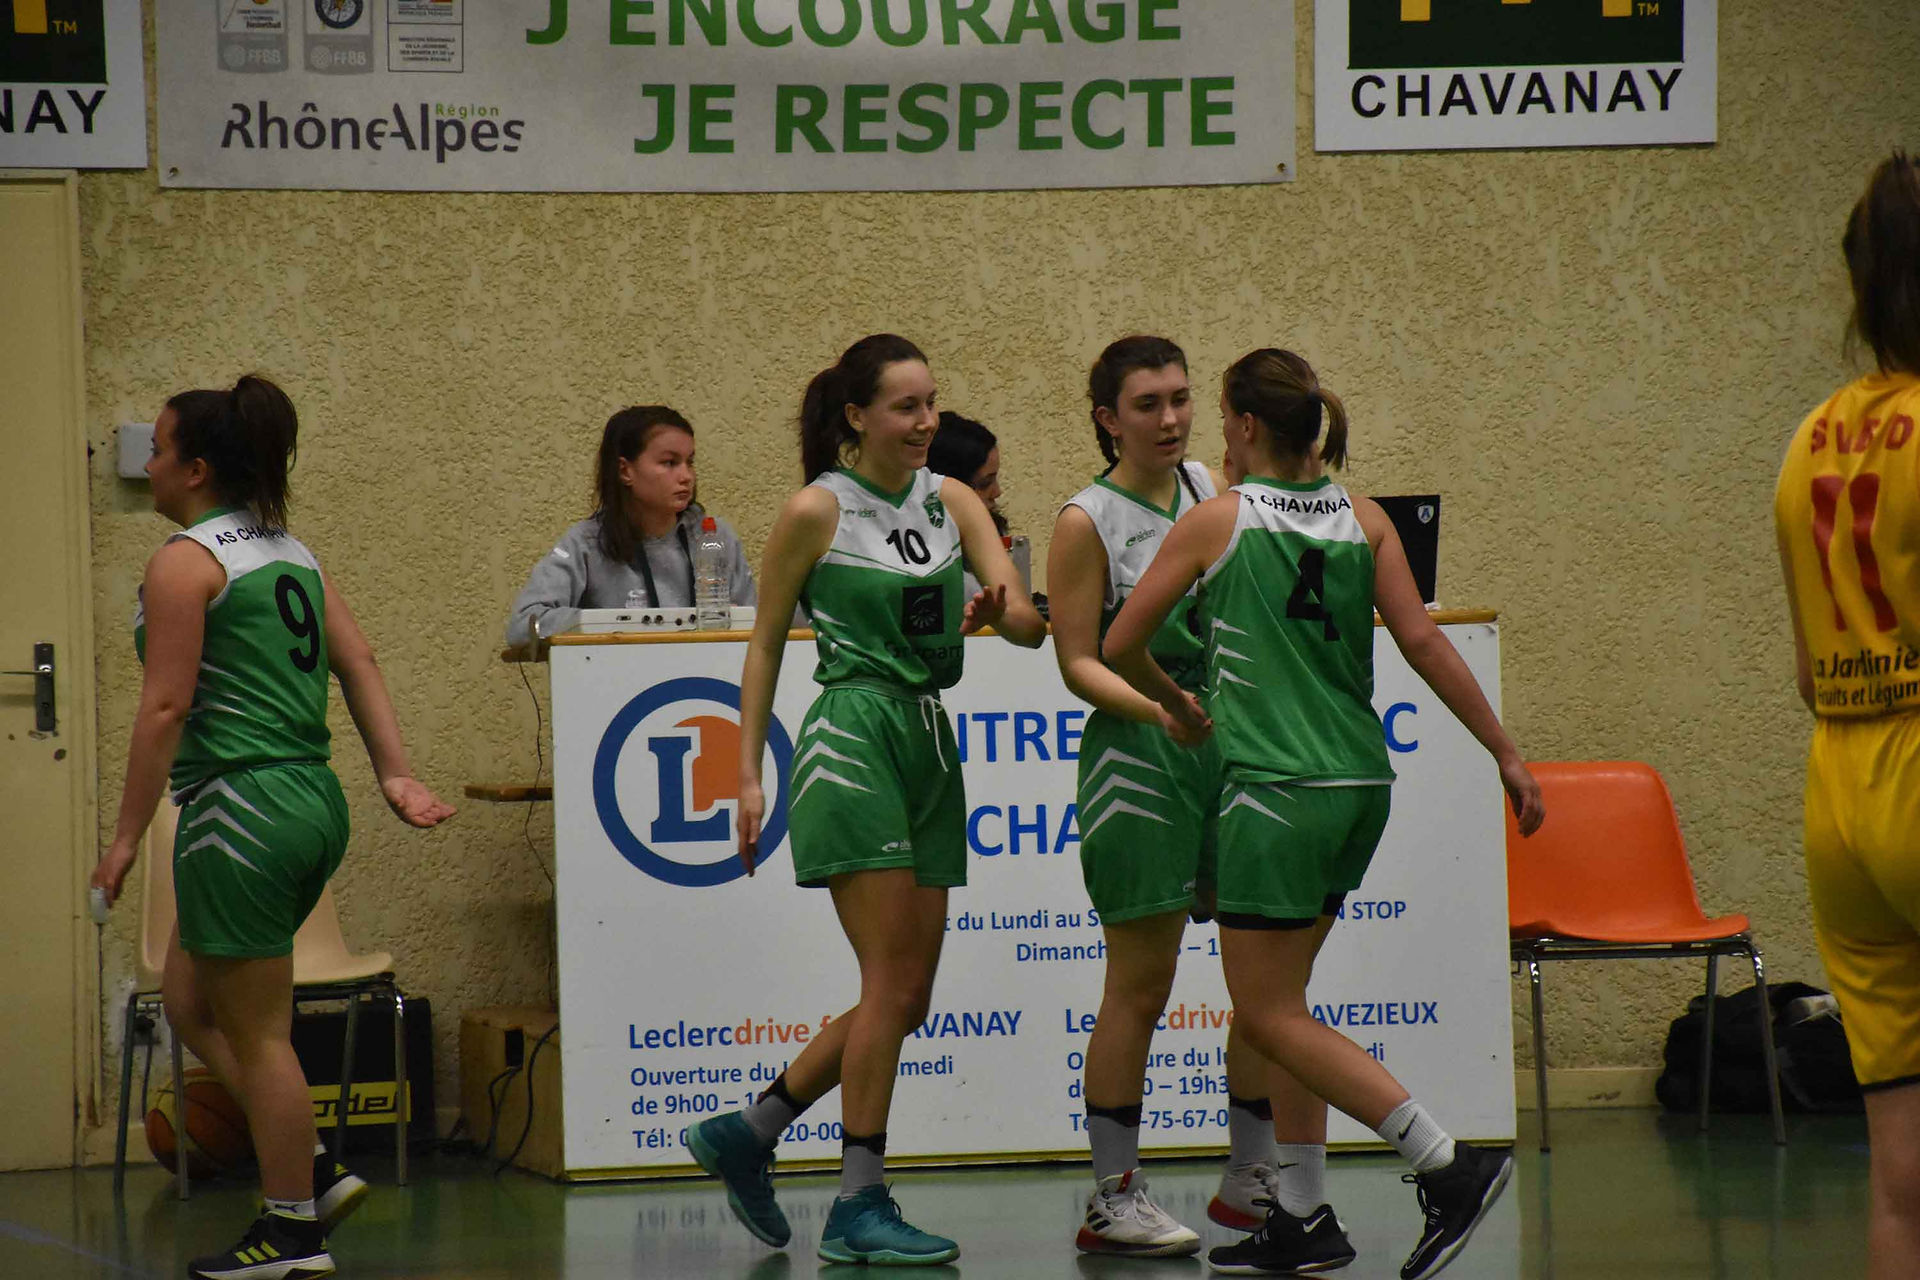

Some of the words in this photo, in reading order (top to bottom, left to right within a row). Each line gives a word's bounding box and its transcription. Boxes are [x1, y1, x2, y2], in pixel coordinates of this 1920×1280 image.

[1351, 68, 1682, 118] CHAVANAY
[435, 103, 500, 119] Région
[634, 84, 735, 154] JE
[775, 76, 1236, 154] RESPECTE
[1260, 494, 1351, 515] CHAVANA
[215, 531, 238, 546] AS
[886, 528, 931, 565] 10
[1286, 548, 1341, 641] 4
[275, 574, 320, 673] 9
[957, 911, 983, 931] du
[991, 909, 1049, 931] Lundi
[1055, 912, 1081, 929] au
[1351, 900, 1407, 920] STOP
[1016, 940, 1107, 962] Dimanch
[1311, 1001, 1438, 1027] AVEZIEUX
[1182, 1047, 1210, 1067] du
[630, 1065, 742, 1087] Ouverture
[749, 1062, 777, 1082] du
[898, 1055, 954, 1077] medi
[1178, 1075, 1230, 1096] 19h3
[631, 1094, 659, 1115] de
[664, 1092, 719, 1114] 9h00
[632, 1128, 673, 1149] Tél:
